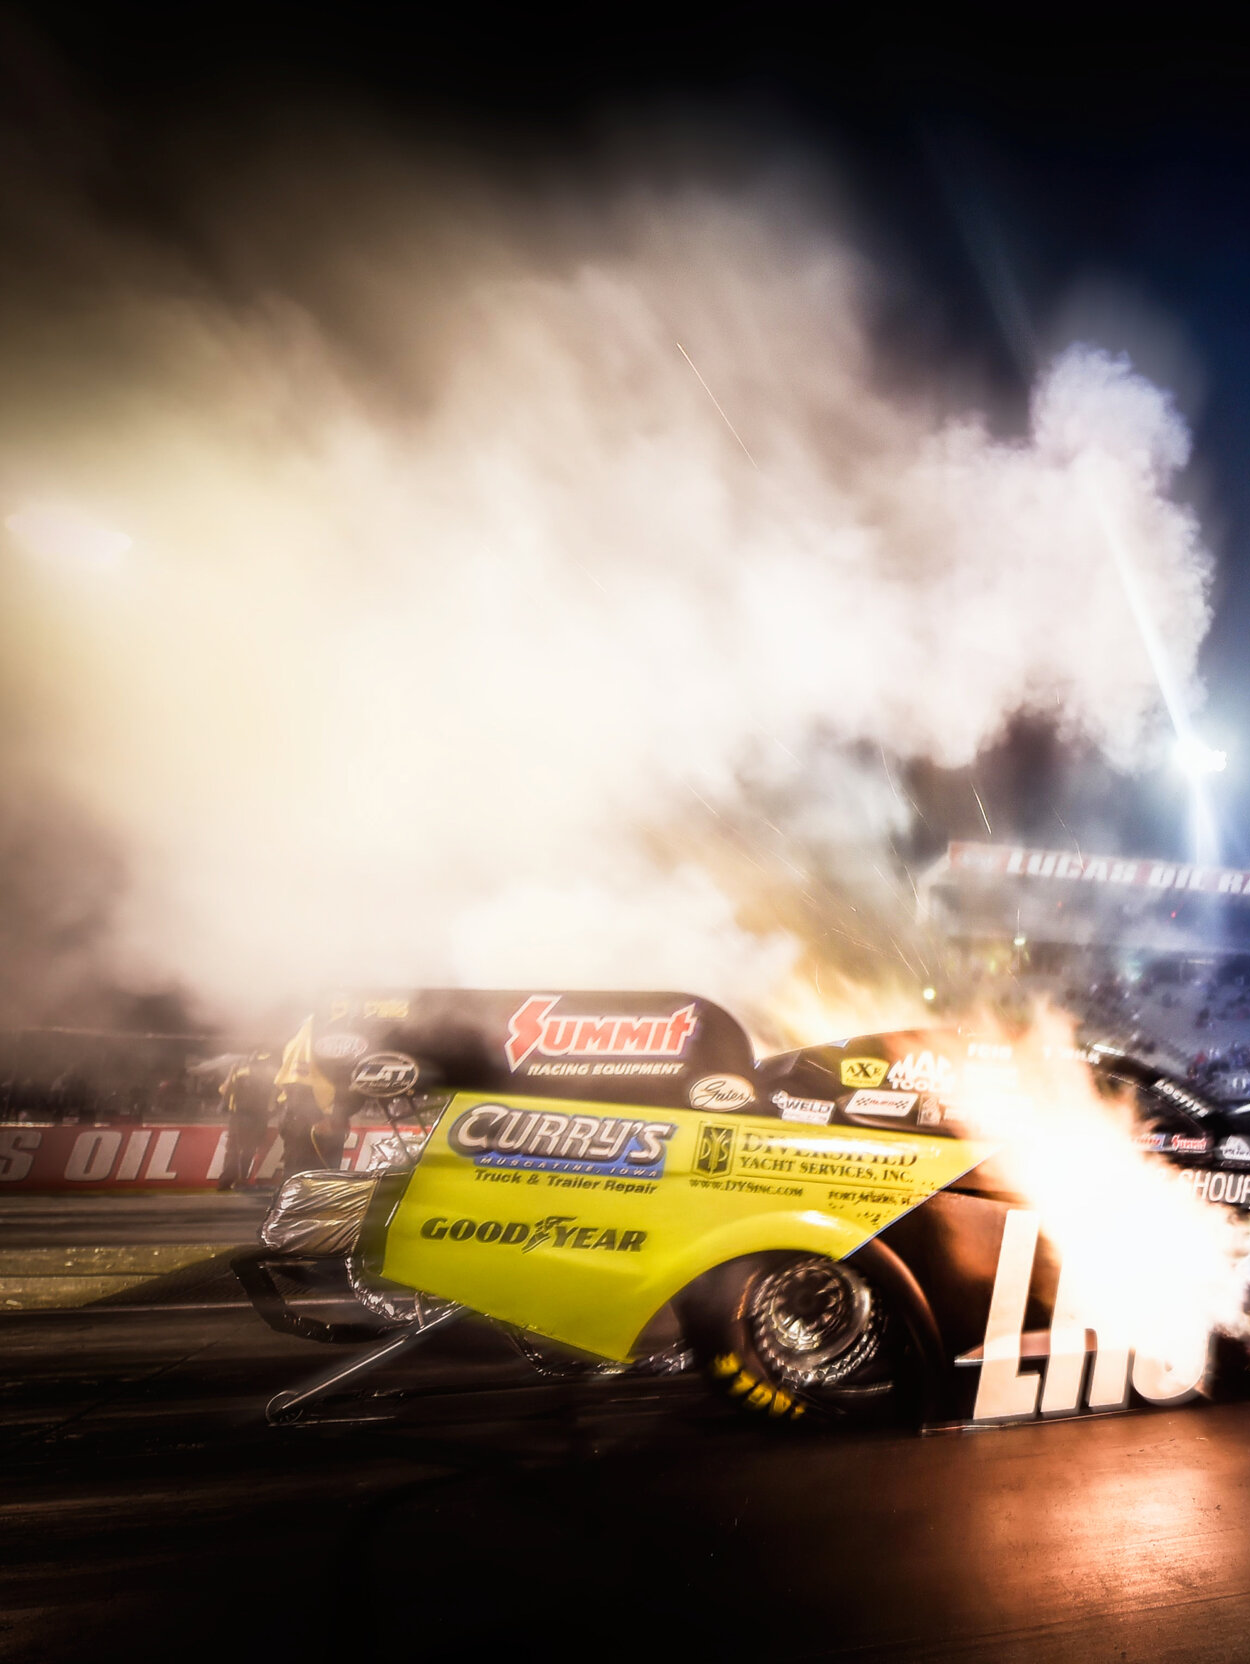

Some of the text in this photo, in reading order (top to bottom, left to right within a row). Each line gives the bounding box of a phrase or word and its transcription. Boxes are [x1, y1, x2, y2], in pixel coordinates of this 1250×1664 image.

[1006, 849, 1138, 884] LUCAS
[1148, 864, 1207, 891] OIL
[526, 1062, 687, 1077] RACING EQUIPMENT
[785, 1099, 831, 1114] WELD
[453, 1104, 676, 1164] CURRY'S
[64, 1130, 181, 1182] OIL
[479, 1156, 659, 1178] MUSCATINE, IOWA
[740, 1156, 914, 1184] YACHT SERVICES, INC.
[474, 1168, 658, 1196] Truck & Trailer Repair
[420, 1217, 648, 1254] GOODYEAR
